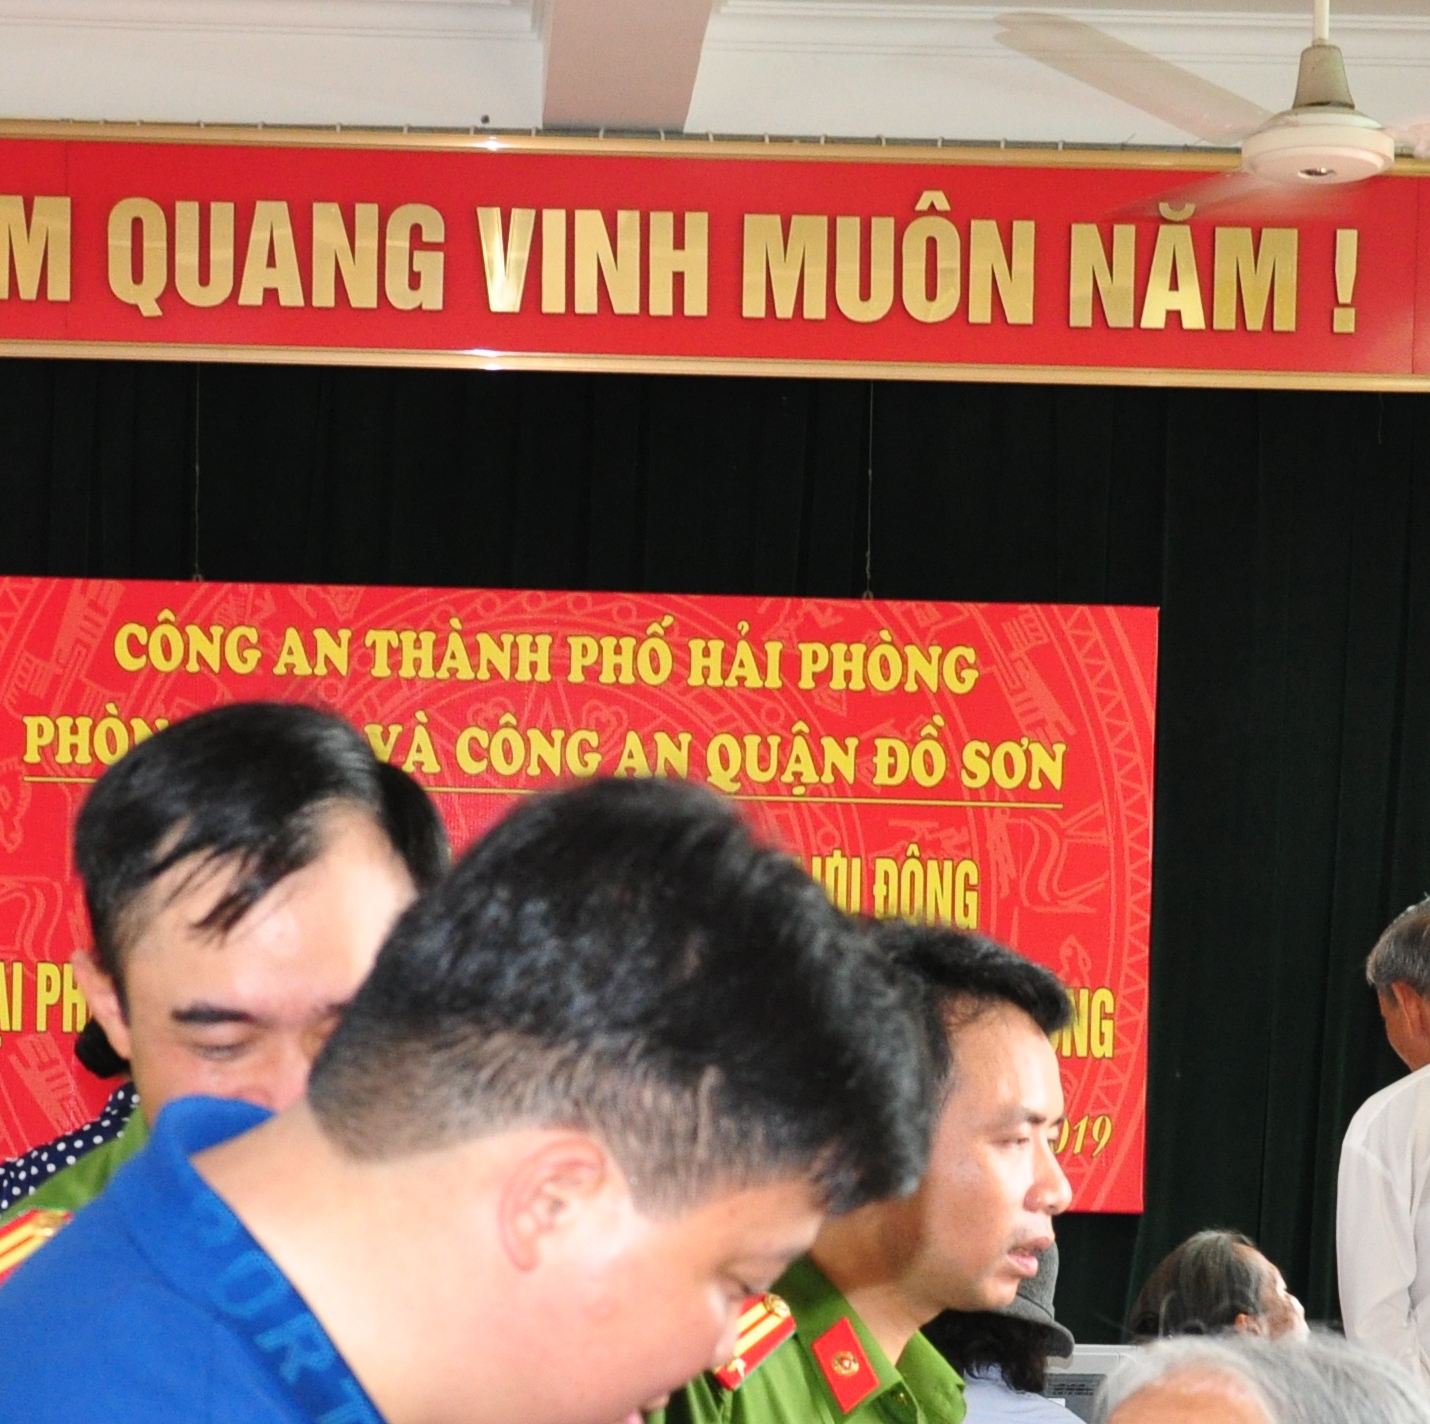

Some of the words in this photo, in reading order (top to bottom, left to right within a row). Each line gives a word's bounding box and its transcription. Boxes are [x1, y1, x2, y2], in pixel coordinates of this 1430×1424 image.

[107, 197, 445, 317] QUANG
[476, 206, 709, 316] VINH
[741, 190, 1036, 325] MUÔN
[1069, 202, 1299, 332] NĂM
[113, 608, 262, 675] CÔNG
[272, 626, 352, 676] AN
[364, 617, 553, 683] THÀNH
[567, 614, 675, 686] PHỐ
[687, 620, 784, 688] HẢI
[797, 628, 979, 694] PHÒNG
[364, 710, 441, 773] VÀ
[456, 712, 602, 777] CÔNG
[613, 730, 692, 779] AN
[706, 720, 859, 795] QUẬN
[872, 713, 947, 788] ĐỒ
[960, 737, 1067, 791] SƠN
[36, 962, 87, 1033] PH
